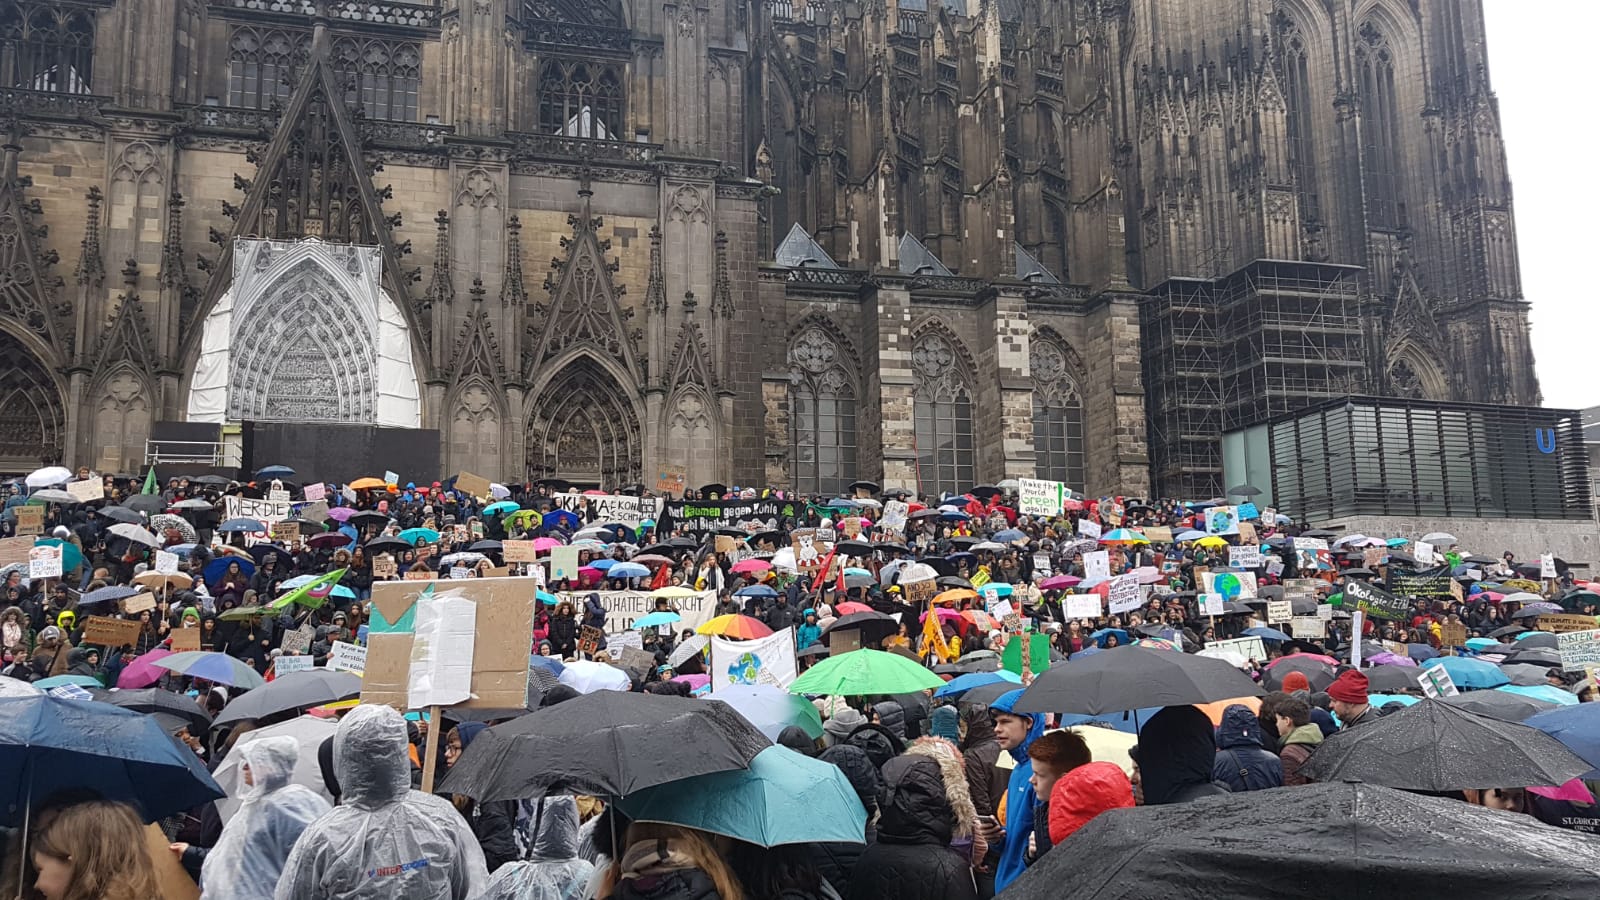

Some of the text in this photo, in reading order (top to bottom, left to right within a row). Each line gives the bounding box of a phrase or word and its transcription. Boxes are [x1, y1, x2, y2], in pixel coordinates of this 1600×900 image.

[1536, 428, 1556, 454] U
[1020, 480, 1057, 491] Make the
[618, 500, 638, 511] KOH
[1021, 493, 1056, 507] Green
[723, 505, 752, 519] gegen
[1347, 579, 1388, 606] Ökologie
[613, 596, 643, 612] HATTE
